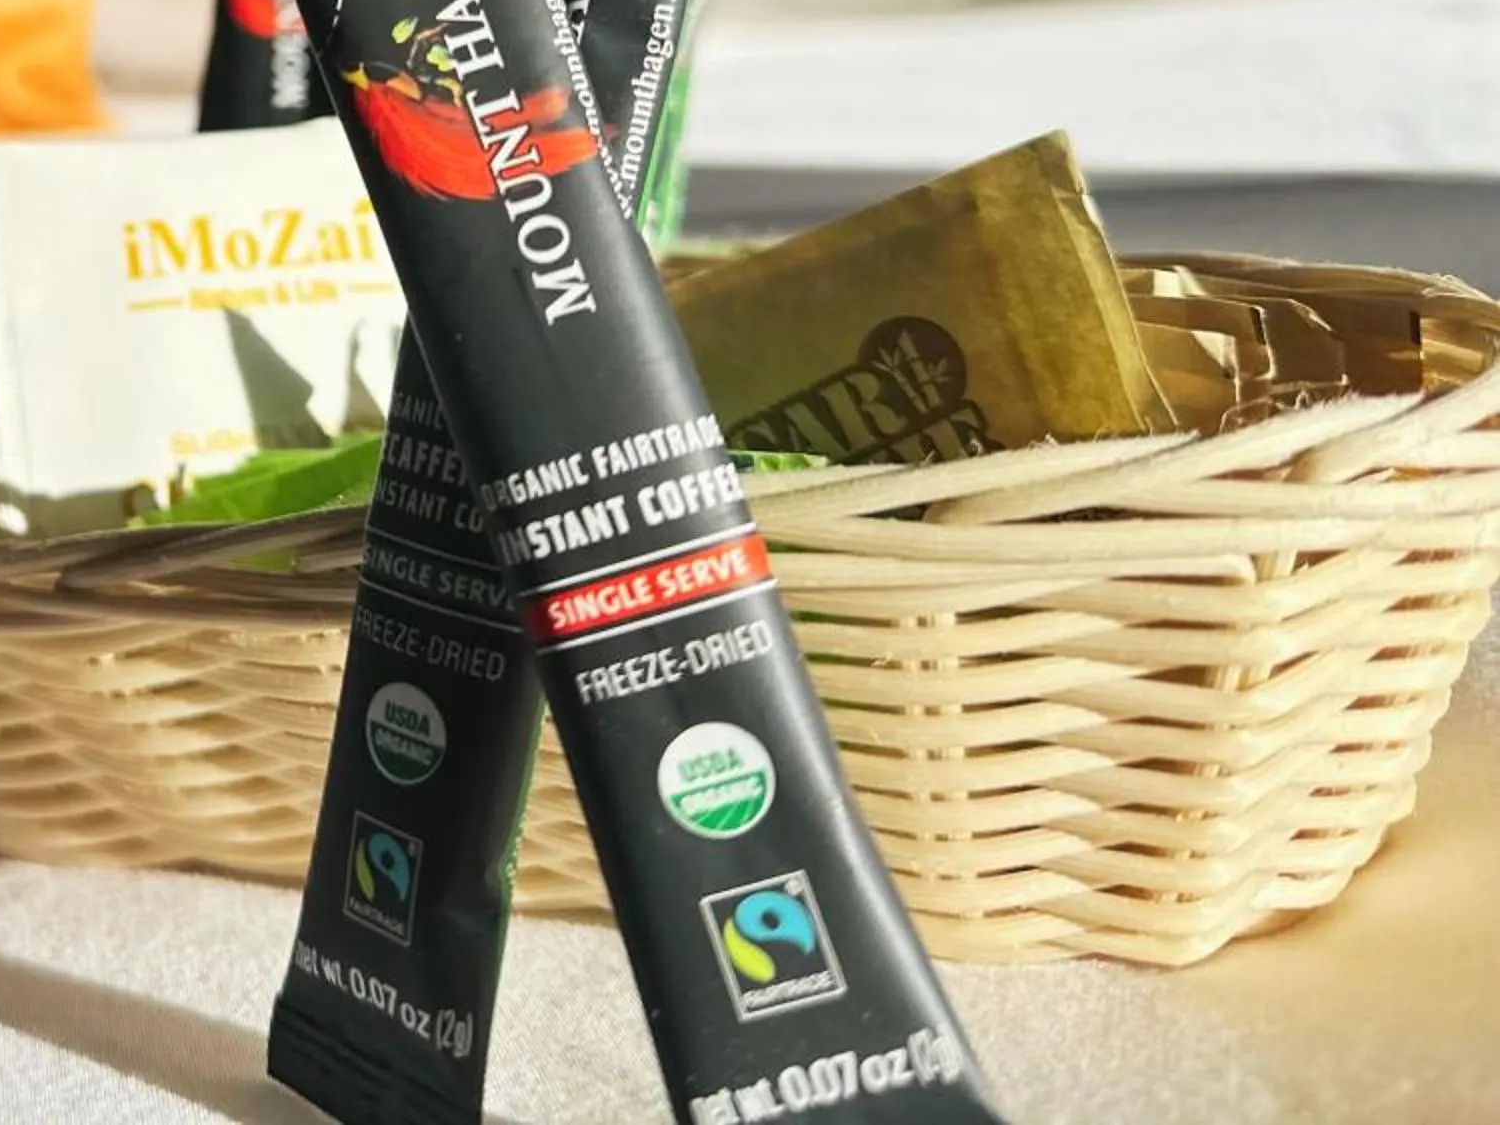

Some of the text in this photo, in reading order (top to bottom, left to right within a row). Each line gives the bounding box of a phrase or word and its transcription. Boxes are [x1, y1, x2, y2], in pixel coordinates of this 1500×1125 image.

[466, 89, 597, 325] MOUNT
[480, 454, 590, 512] ORGANIC
[363, 541, 431, 589] SINGLE
[497, 495, 630, 566] INSTANT
[547, 546, 750, 630] SINGLE SERVE
[355, 604, 507, 682] FREEZE-DRIED
[575, 618, 775, 706] FREEZE-DRIED
[384, 698, 431, 737] USDA
[349, 965, 398, 1015] 0.07
[400, 1001, 431, 1040] oz
[436, 1007, 475, 1058] (2g)
[860, 1047, 916, 1095] oz
